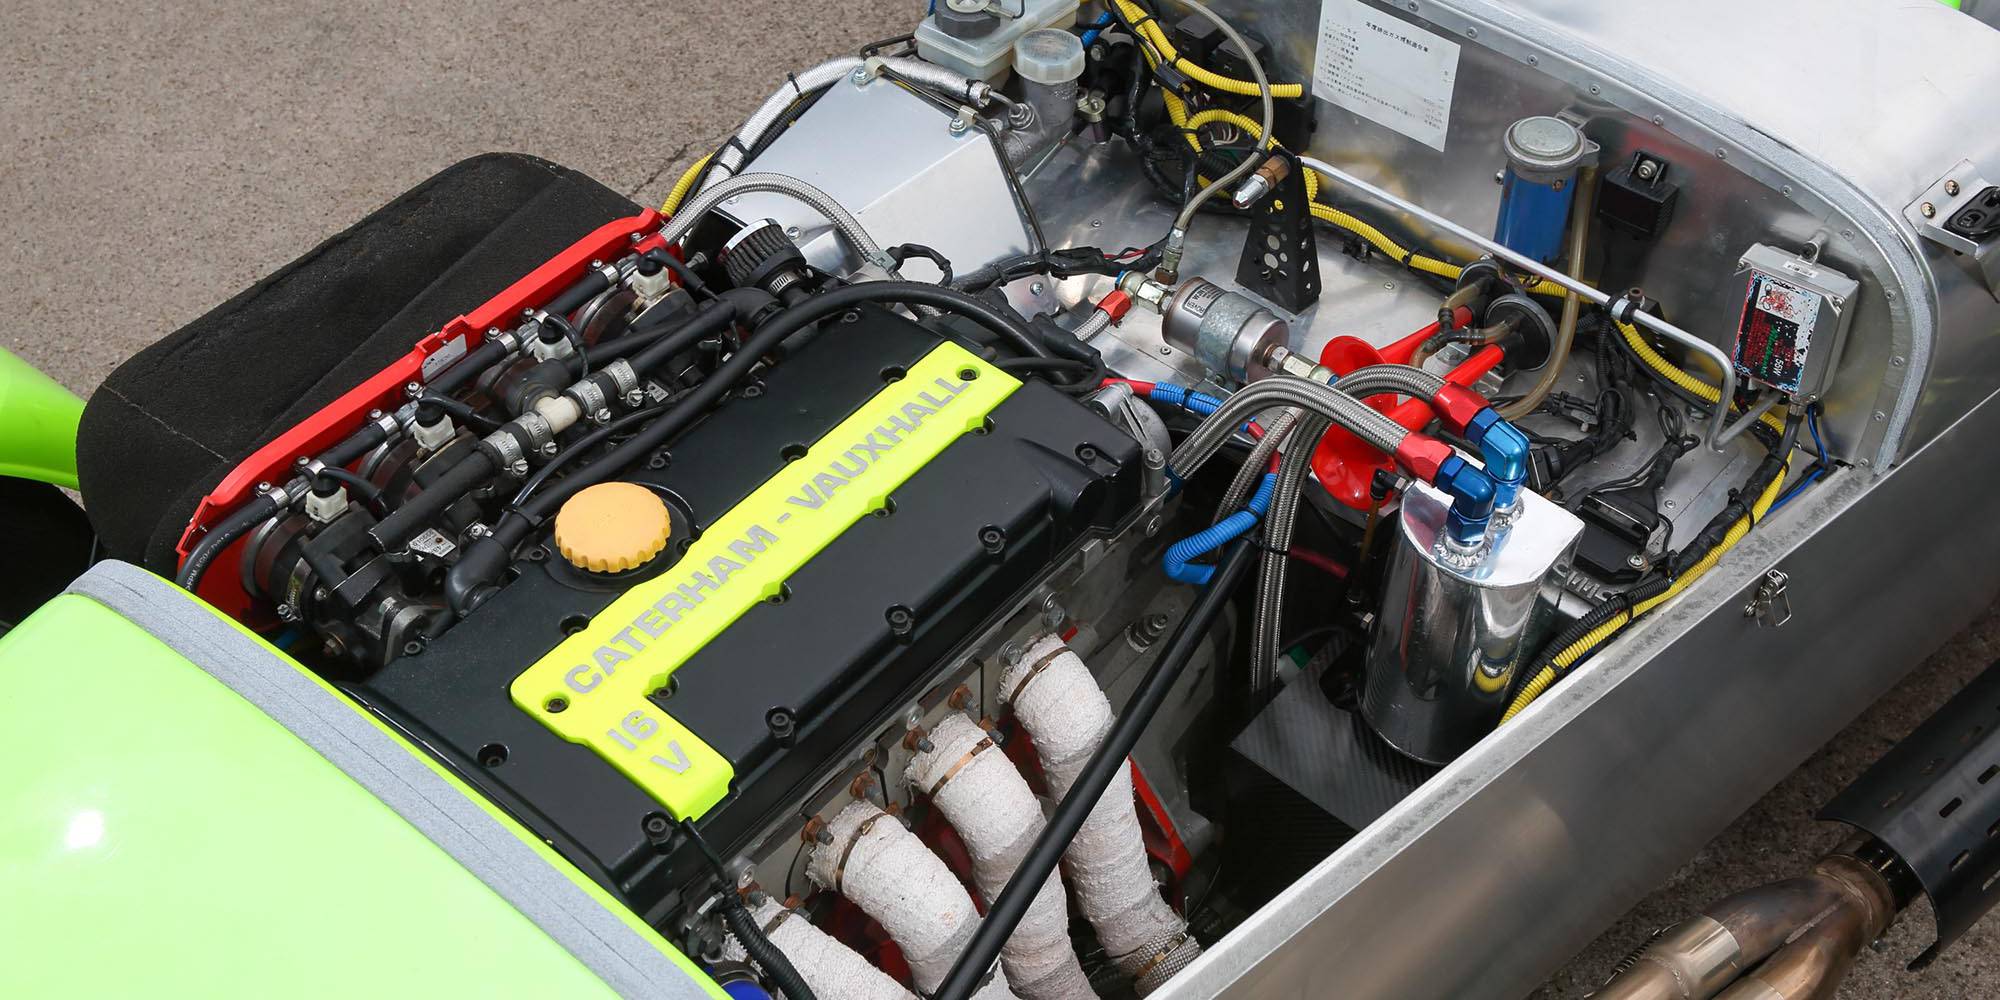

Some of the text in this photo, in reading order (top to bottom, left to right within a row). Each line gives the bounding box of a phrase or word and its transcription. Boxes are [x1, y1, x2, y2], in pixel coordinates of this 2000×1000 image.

[1772, 358, 1785, 376] 55W
[564, 376, 970, 694] CATERHAM - VAUXHALL
[651, 740, 691, 775] V
